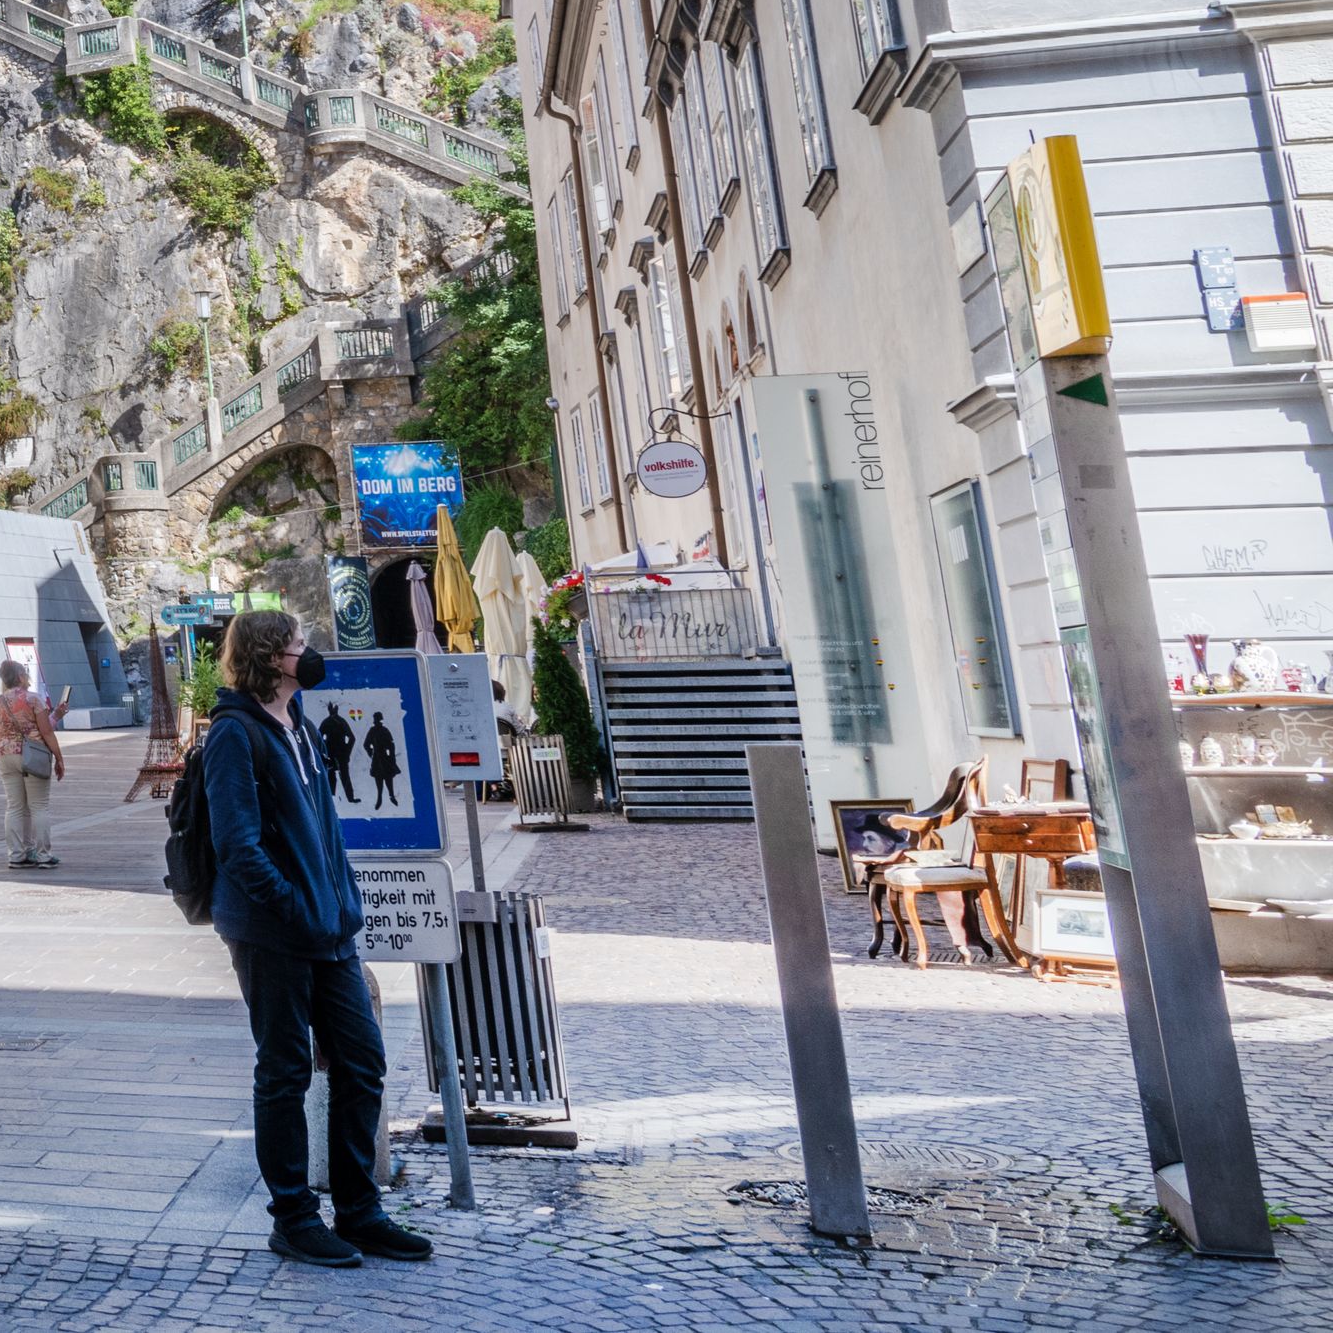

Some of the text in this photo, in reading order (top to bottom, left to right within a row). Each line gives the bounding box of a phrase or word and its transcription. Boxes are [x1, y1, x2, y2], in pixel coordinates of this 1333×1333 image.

[1209, 297, 1225, 307] HS
[837, 371, 885, 490] reinerhof
[361, 476, 456, 495] DOM IM BERG
[650, 611, 730, 639] Mur
[354, 870, 426, 882] enommen
[362, 888, 436, 909] tigkeit mit
[365, 911, 448, 931] gen bis 7,5t
